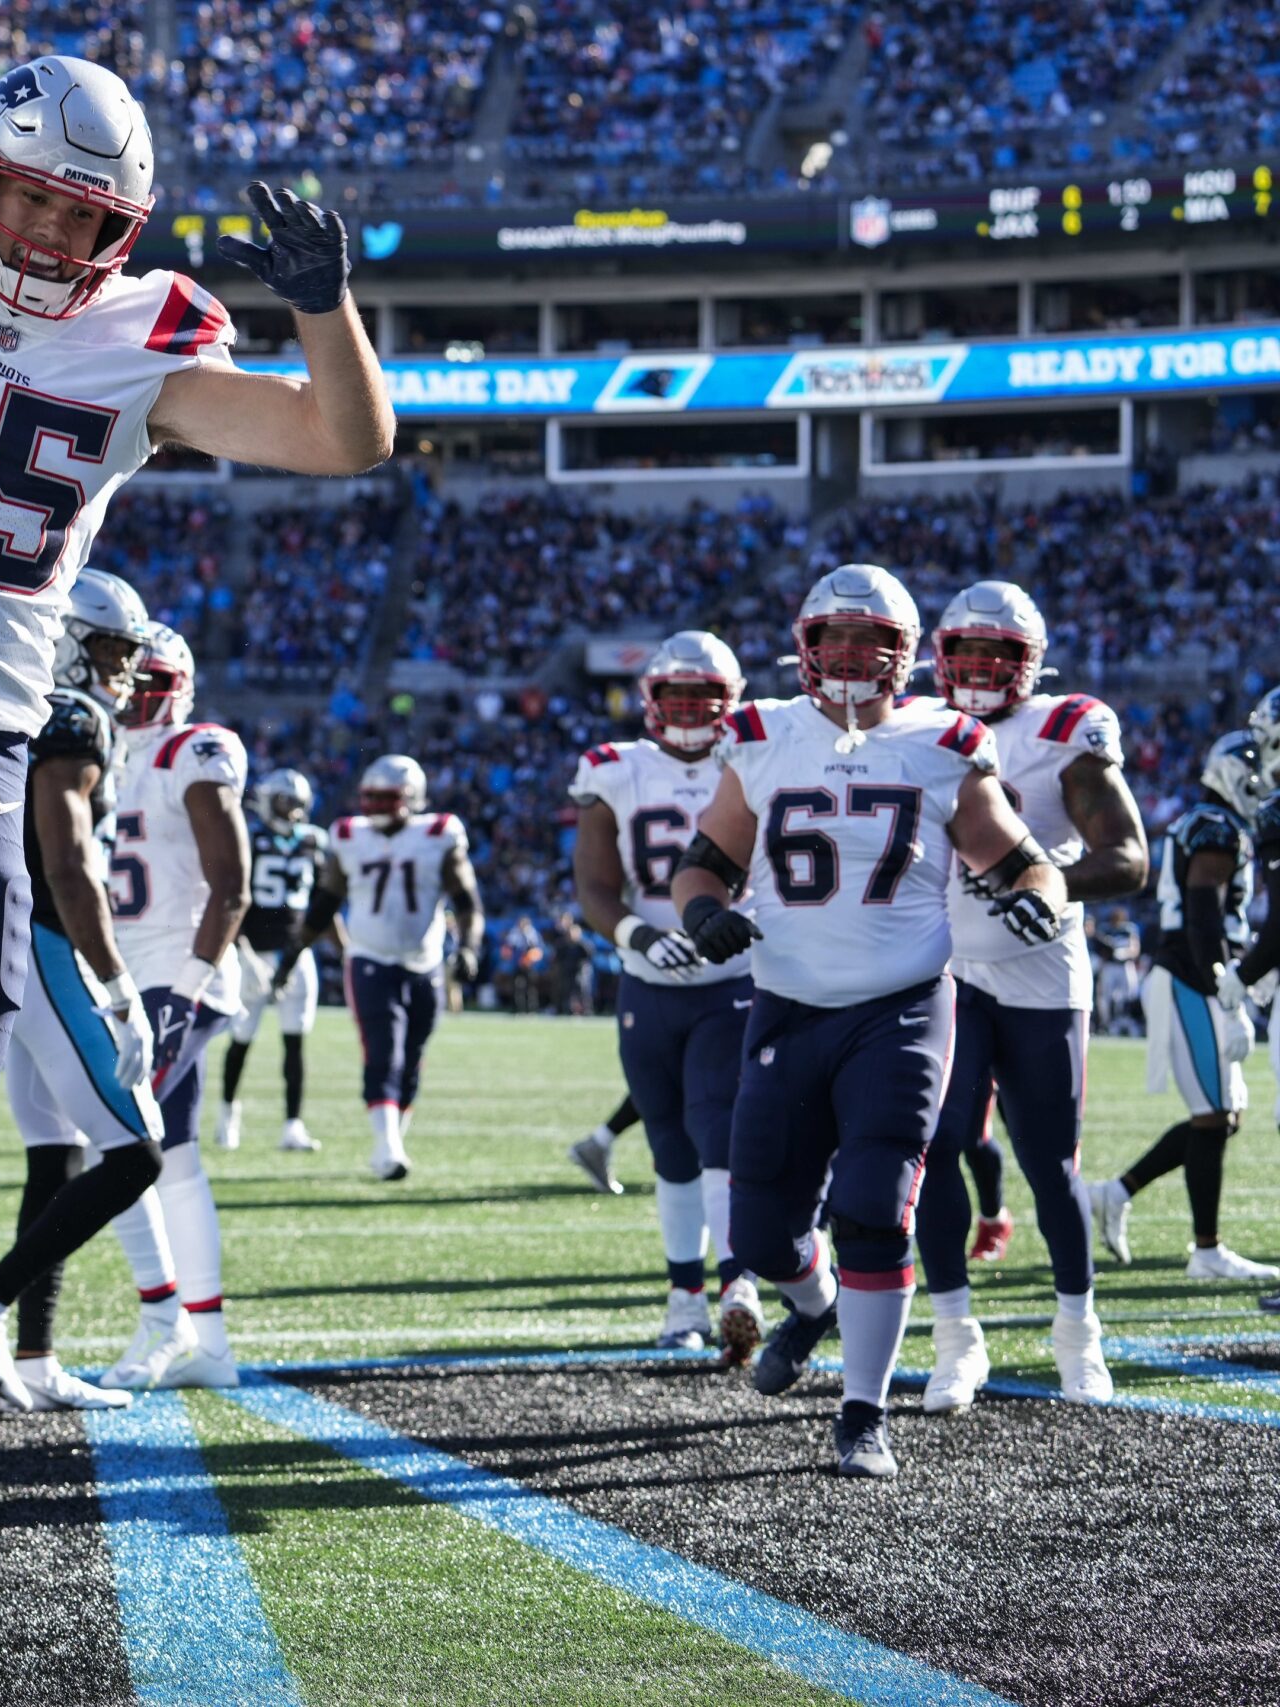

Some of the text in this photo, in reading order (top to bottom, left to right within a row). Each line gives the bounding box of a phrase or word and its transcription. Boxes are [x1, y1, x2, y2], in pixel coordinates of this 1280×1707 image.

[63, 167, 110, 192] PATRIOTS
[1183, 168, 1236, 196] HOU
[988, 186, 1040, 215] BUF
[1183, 195, 1229, 222] MIA
[989, 211, 1038, 239] JAX
[1121, 205, 1139, 231] 2
[1007, 346, 1146, 389] READY
[1148, 342, 1228, 381] FOR
[492, 367, 578, 404] DAY
[630, 803, 691, 902] 6
[767, 784, 922, 907] 67
[362, 857, 417, 914] 71
